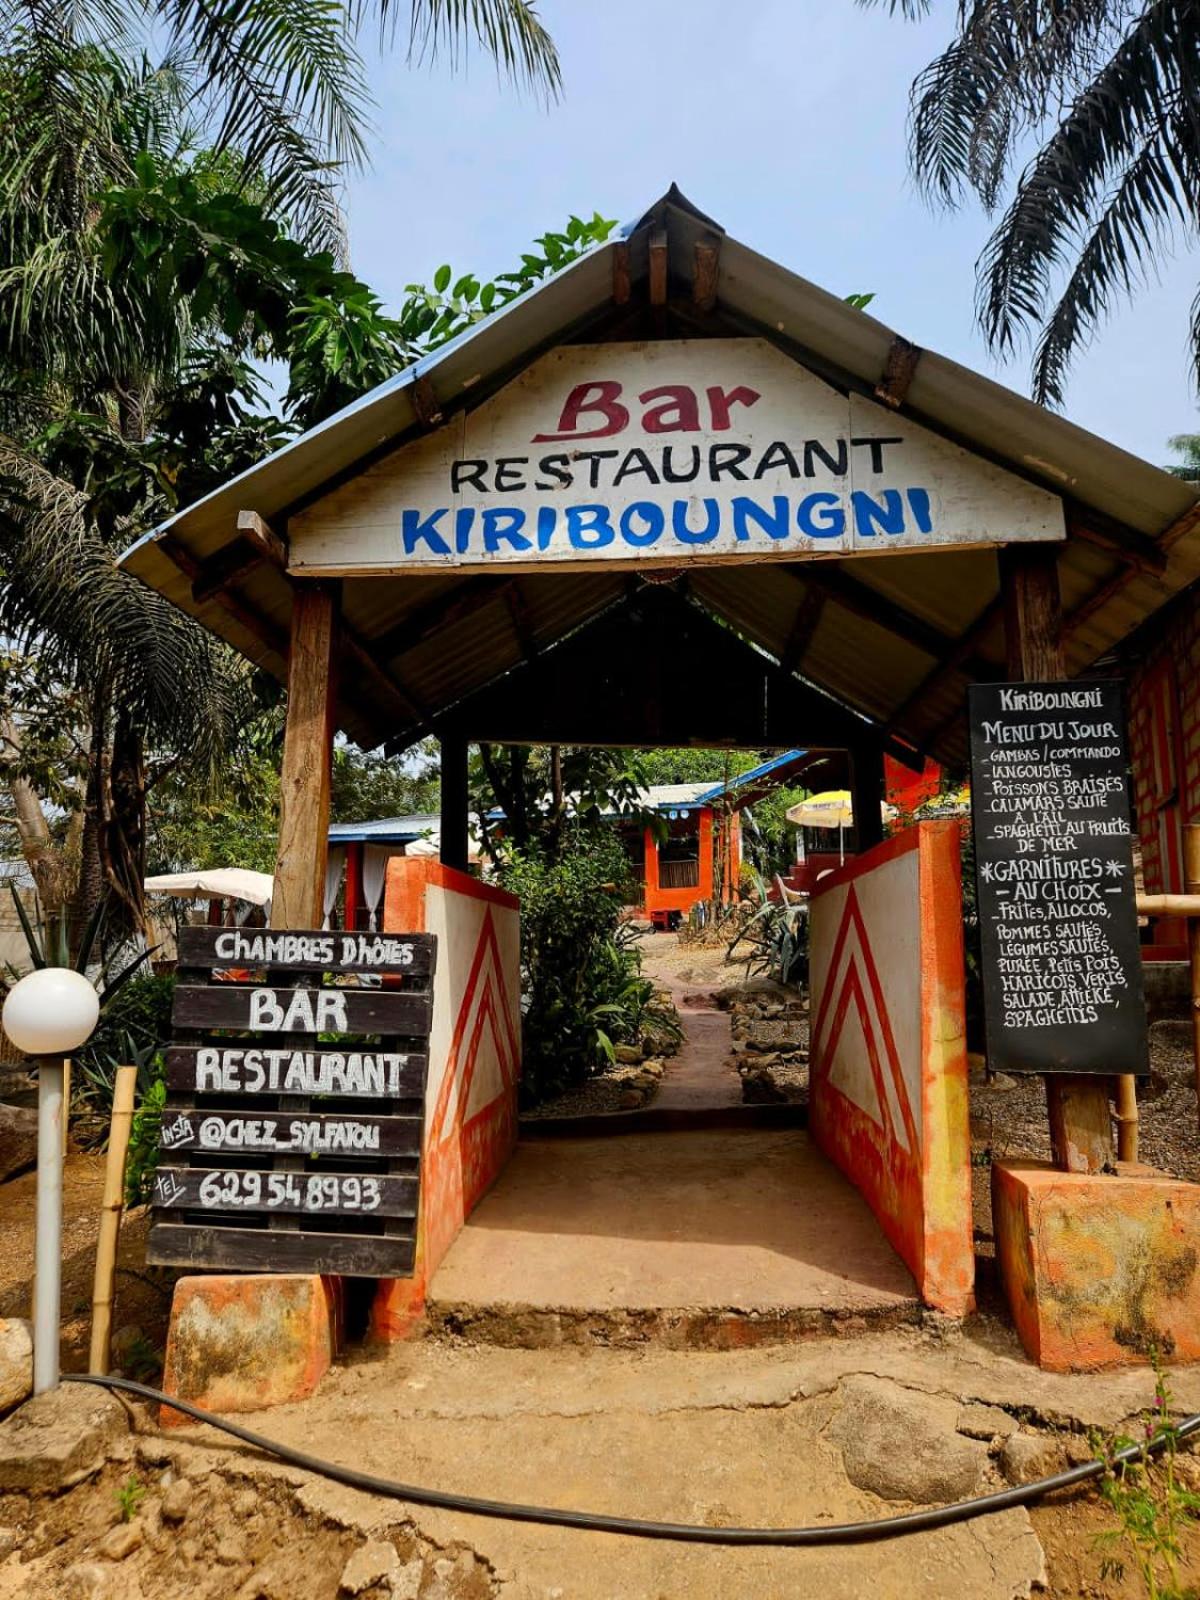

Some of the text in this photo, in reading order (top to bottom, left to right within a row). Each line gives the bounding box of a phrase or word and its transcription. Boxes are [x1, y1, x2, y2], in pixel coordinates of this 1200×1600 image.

[530, 381, 761, 443] Bar
[451, 437, 904, 495] RESTAURANT
[402, 488, 933, 555] KIRIBOUNGNI
[981, 721, 1119, 744] MENU DU JOUR
[990, 749, 1040, 762] GAMBAS
[1049, 746, 1121, 759] COMMANDO
[992, 761, 1072, 778] LANGOUSTES
[1064, 821, 1086, 836] AU
[1015, 836, 1079, 853] DE MER
[1014, 881, 1040, 900] AU
[996, 923, 1051, 940] POMMES
[250, 990, 348, 1032] BAR
[195, 1049, 408, 1093] RESTAURANT
